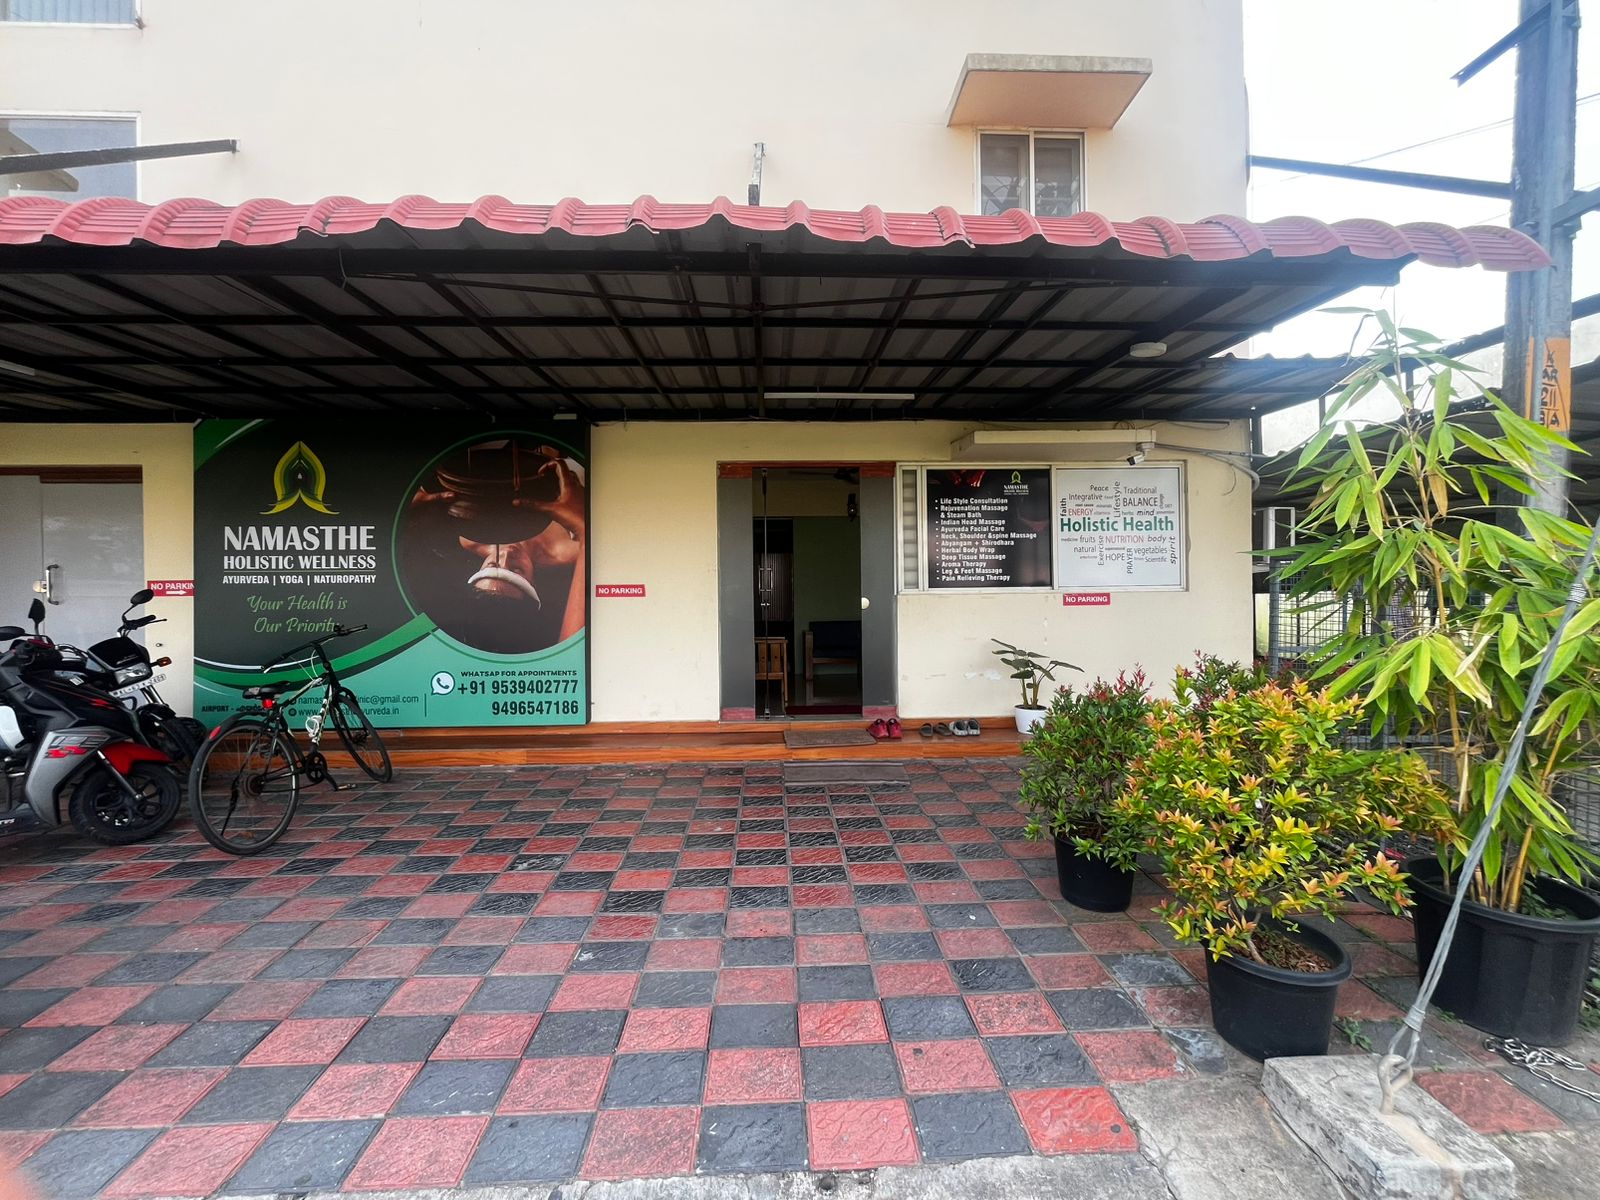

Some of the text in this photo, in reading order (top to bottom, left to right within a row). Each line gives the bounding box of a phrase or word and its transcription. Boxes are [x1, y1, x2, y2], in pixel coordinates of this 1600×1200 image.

[1124, 486, 1158, 494] Traditional
[1068, 493, 1103, 502] Integrative
[1113, 481, 1122, 518] Lifestyle
[1122, 497, 1158, 507] BALANCE
[1068, 508, 1094, 516] ENERGY
[1137, 508, 1155, 516] mind
[1060, 515, 1174, 532] Holistic Health
[224, 525, 377, 551] NAMASTHE
[1079, 534, 1096, 543] fruits
[1105, 534, 1144, 543] NUTRITION
[1147, 534, 1167, 544] body
[1134, 545, 1168, 556] vegetables
[1168, 536, 1178, 565] spirit
[1105, 552, 1125, 561] HOPE
[1126, 547, 1134, 574] PRAYER
[223, 555, 377, 570] HOLISTIC WELLNESS
[222, 574, 377, 584] AYURVEDA YOGA NATUROPATHY
[150, 582, 194, 590] NO PARKIN
[246, 591, 348, 612] Your Health is
[254, 616, 282, 632] Our
[457, 679, 579, 695] +91 9539402777
[491, 700, 580, 716] 9496547186
